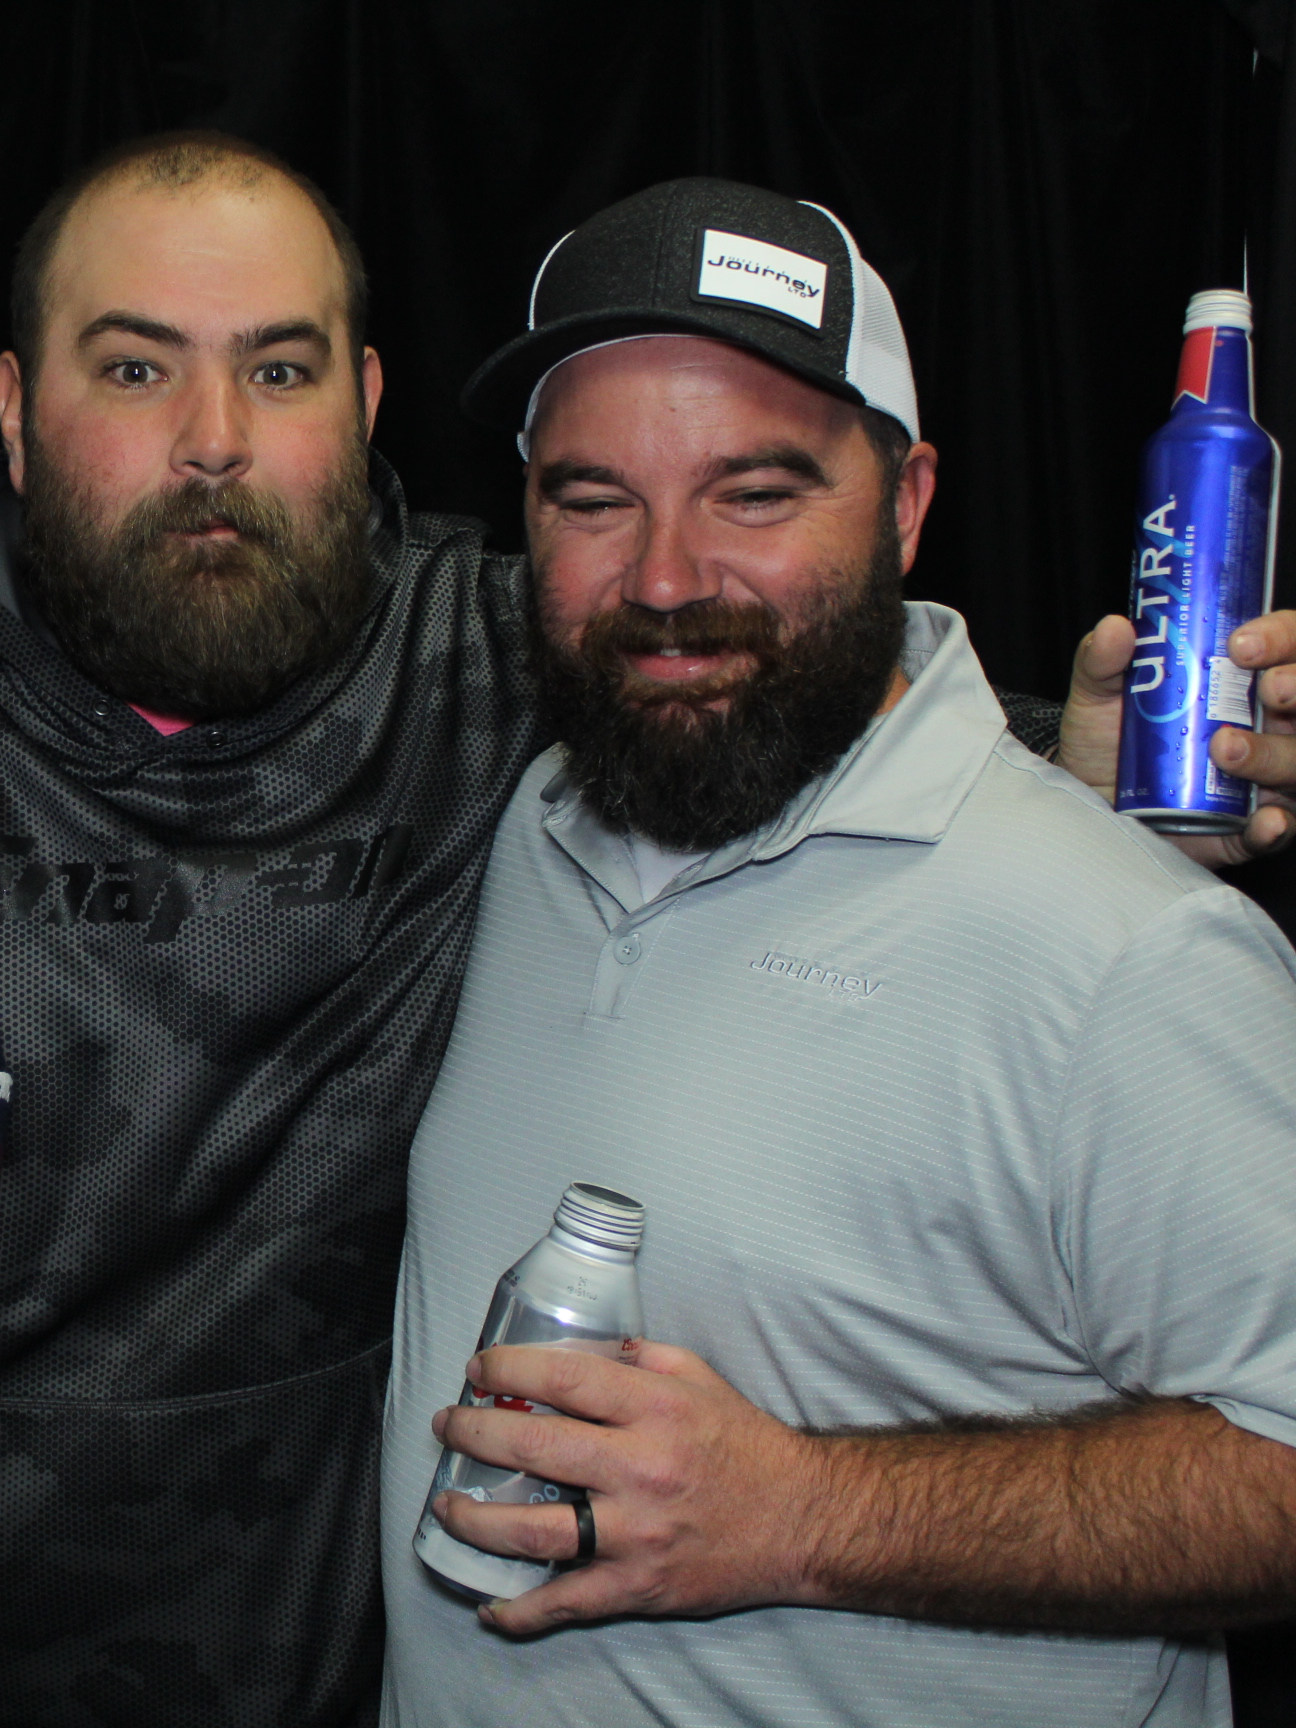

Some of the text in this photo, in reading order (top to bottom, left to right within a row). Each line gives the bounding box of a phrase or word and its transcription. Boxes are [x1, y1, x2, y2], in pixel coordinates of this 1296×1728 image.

[707, 255, 821, 298] Journey
[787, 286, 807, 298] LTD
[1130, 499, 1177, 694] ULTRA
[1175, 524, 1196, 667] SUPERIOR LIGHT BEER
[749, 951, 883, 1000] Journey
